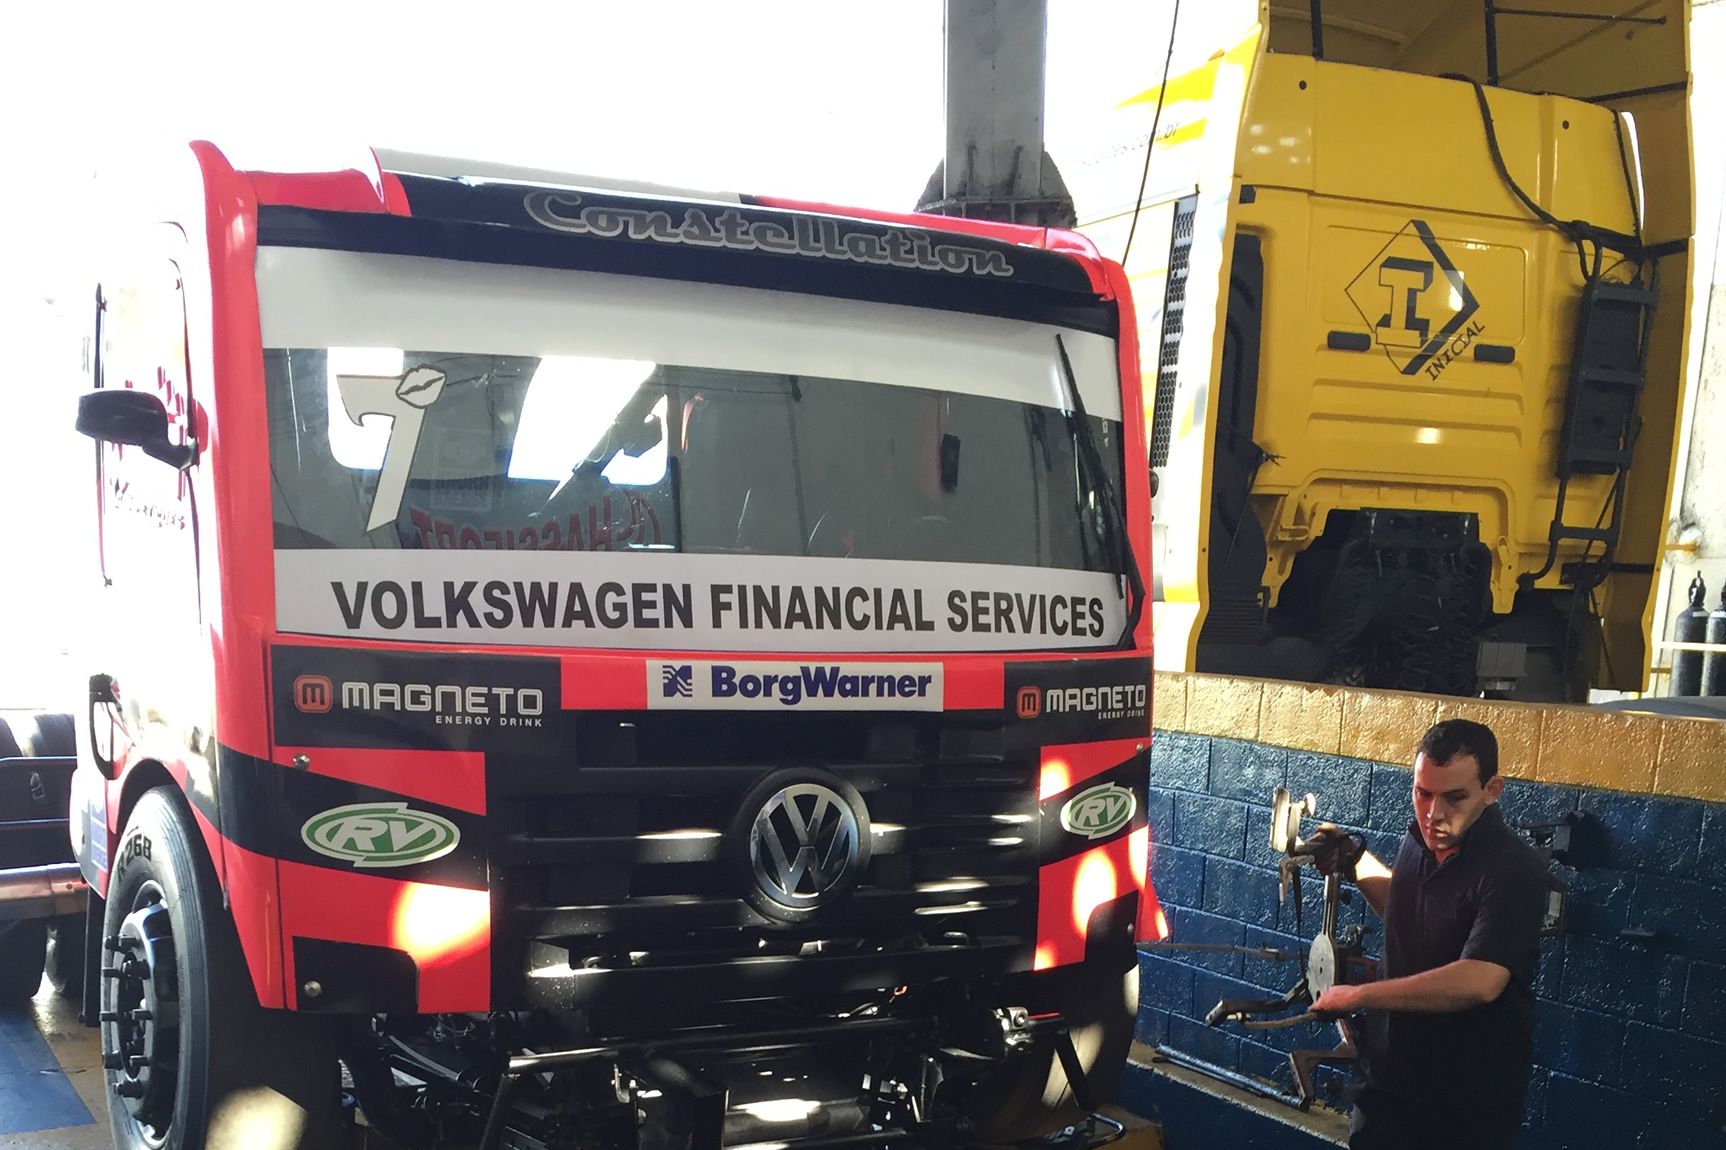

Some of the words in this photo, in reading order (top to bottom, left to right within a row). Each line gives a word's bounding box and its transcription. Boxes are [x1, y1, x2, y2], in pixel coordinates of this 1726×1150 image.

[523, 190, 1014, 277] Constellation
[1424, 320, 1486, 381] INICIAL
[330, 580, 694, 630] VOLKSWAGEN
[710, 584, 935, 632] FINANCIAL
[947, 589, 1105, 637] SERVICES
[342, 682, 543, 716] MAGNETO
[711, 665, 932, 705] BorgWarner
[1046, 684, 1146, 713] MAGNETO
[436, 715, 491, 726] ENERGY
[500, 717, 542, 727] DRINK
[1098, 710, 1124, 720] ENERGY
[1127, 709, 1145, 718] DRINK
